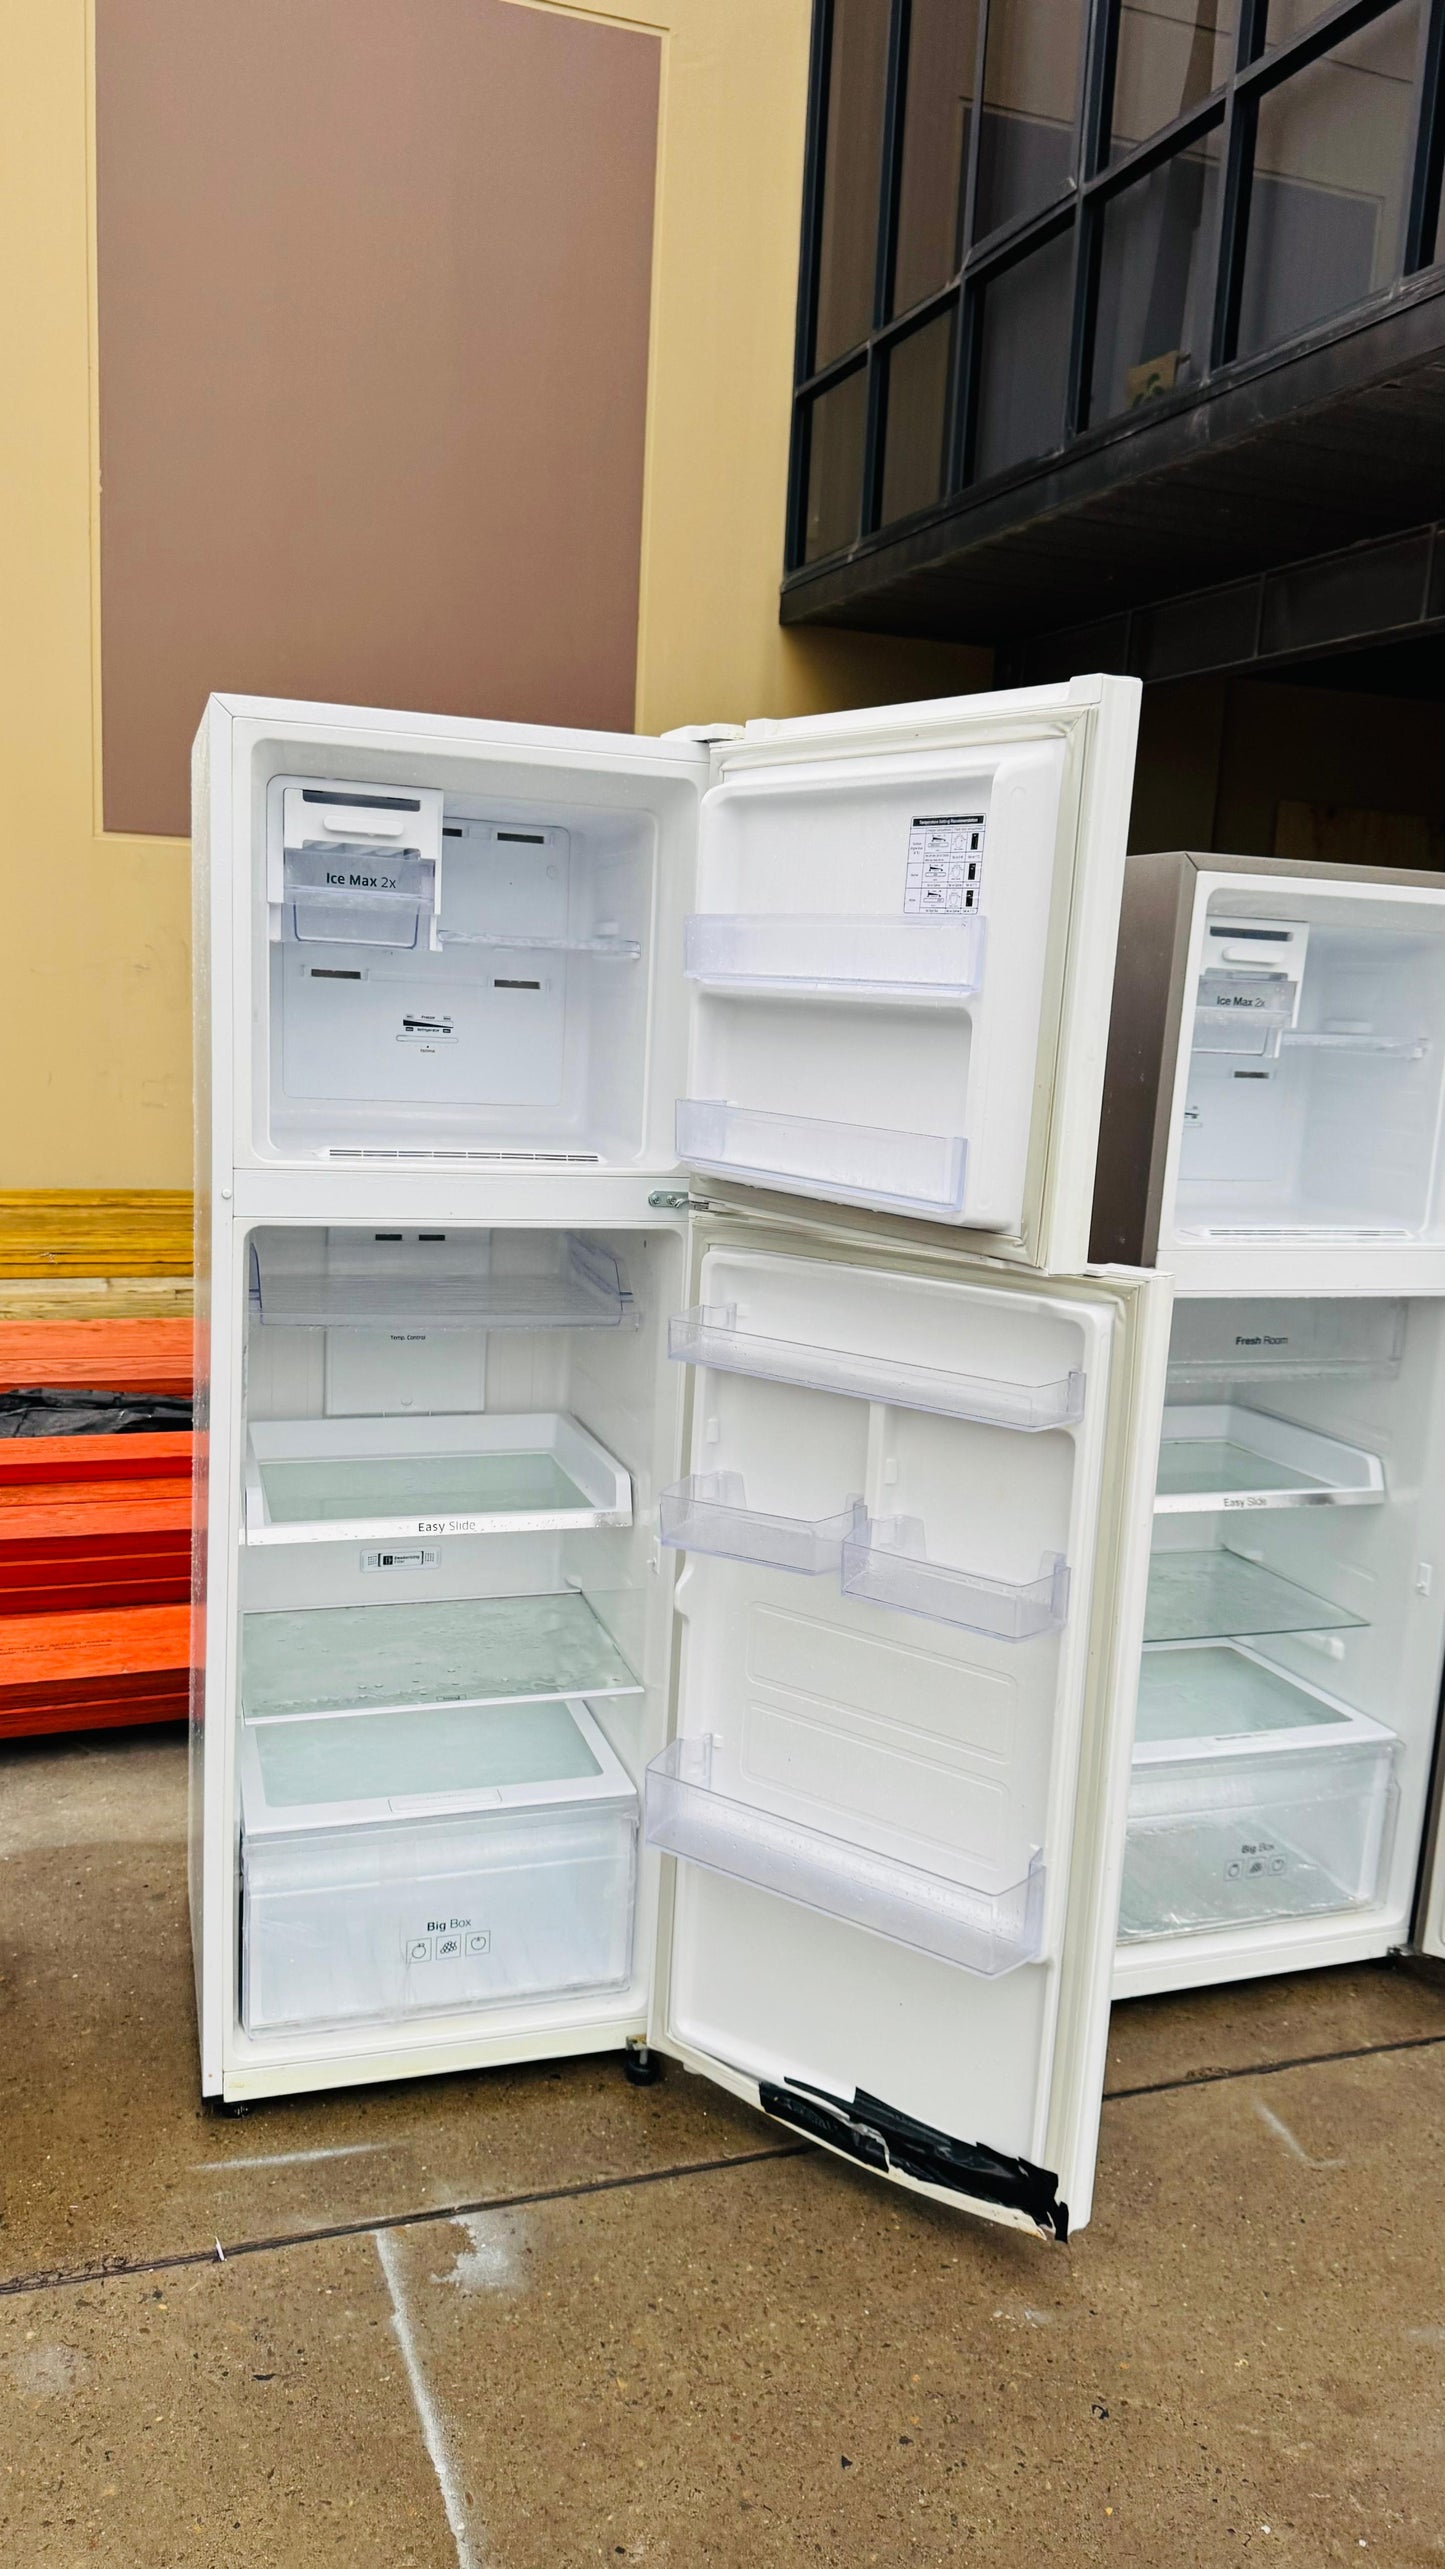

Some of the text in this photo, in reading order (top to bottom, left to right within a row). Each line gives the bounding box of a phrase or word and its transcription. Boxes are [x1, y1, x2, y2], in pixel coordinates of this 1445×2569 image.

[326, 872, 397, 889] Ice Max 2x
[1216, 995, 1231, 1006] Ice
[1232, 996, 1253, 1007] Max
[1235, 1335, 1289, 1346] Fresh Room
[1223, 1498, 1245, 1509] Easy
[418, 1520, 476, 1534] Easy Slide
[427, 1918, 472, 1933] Big Box
